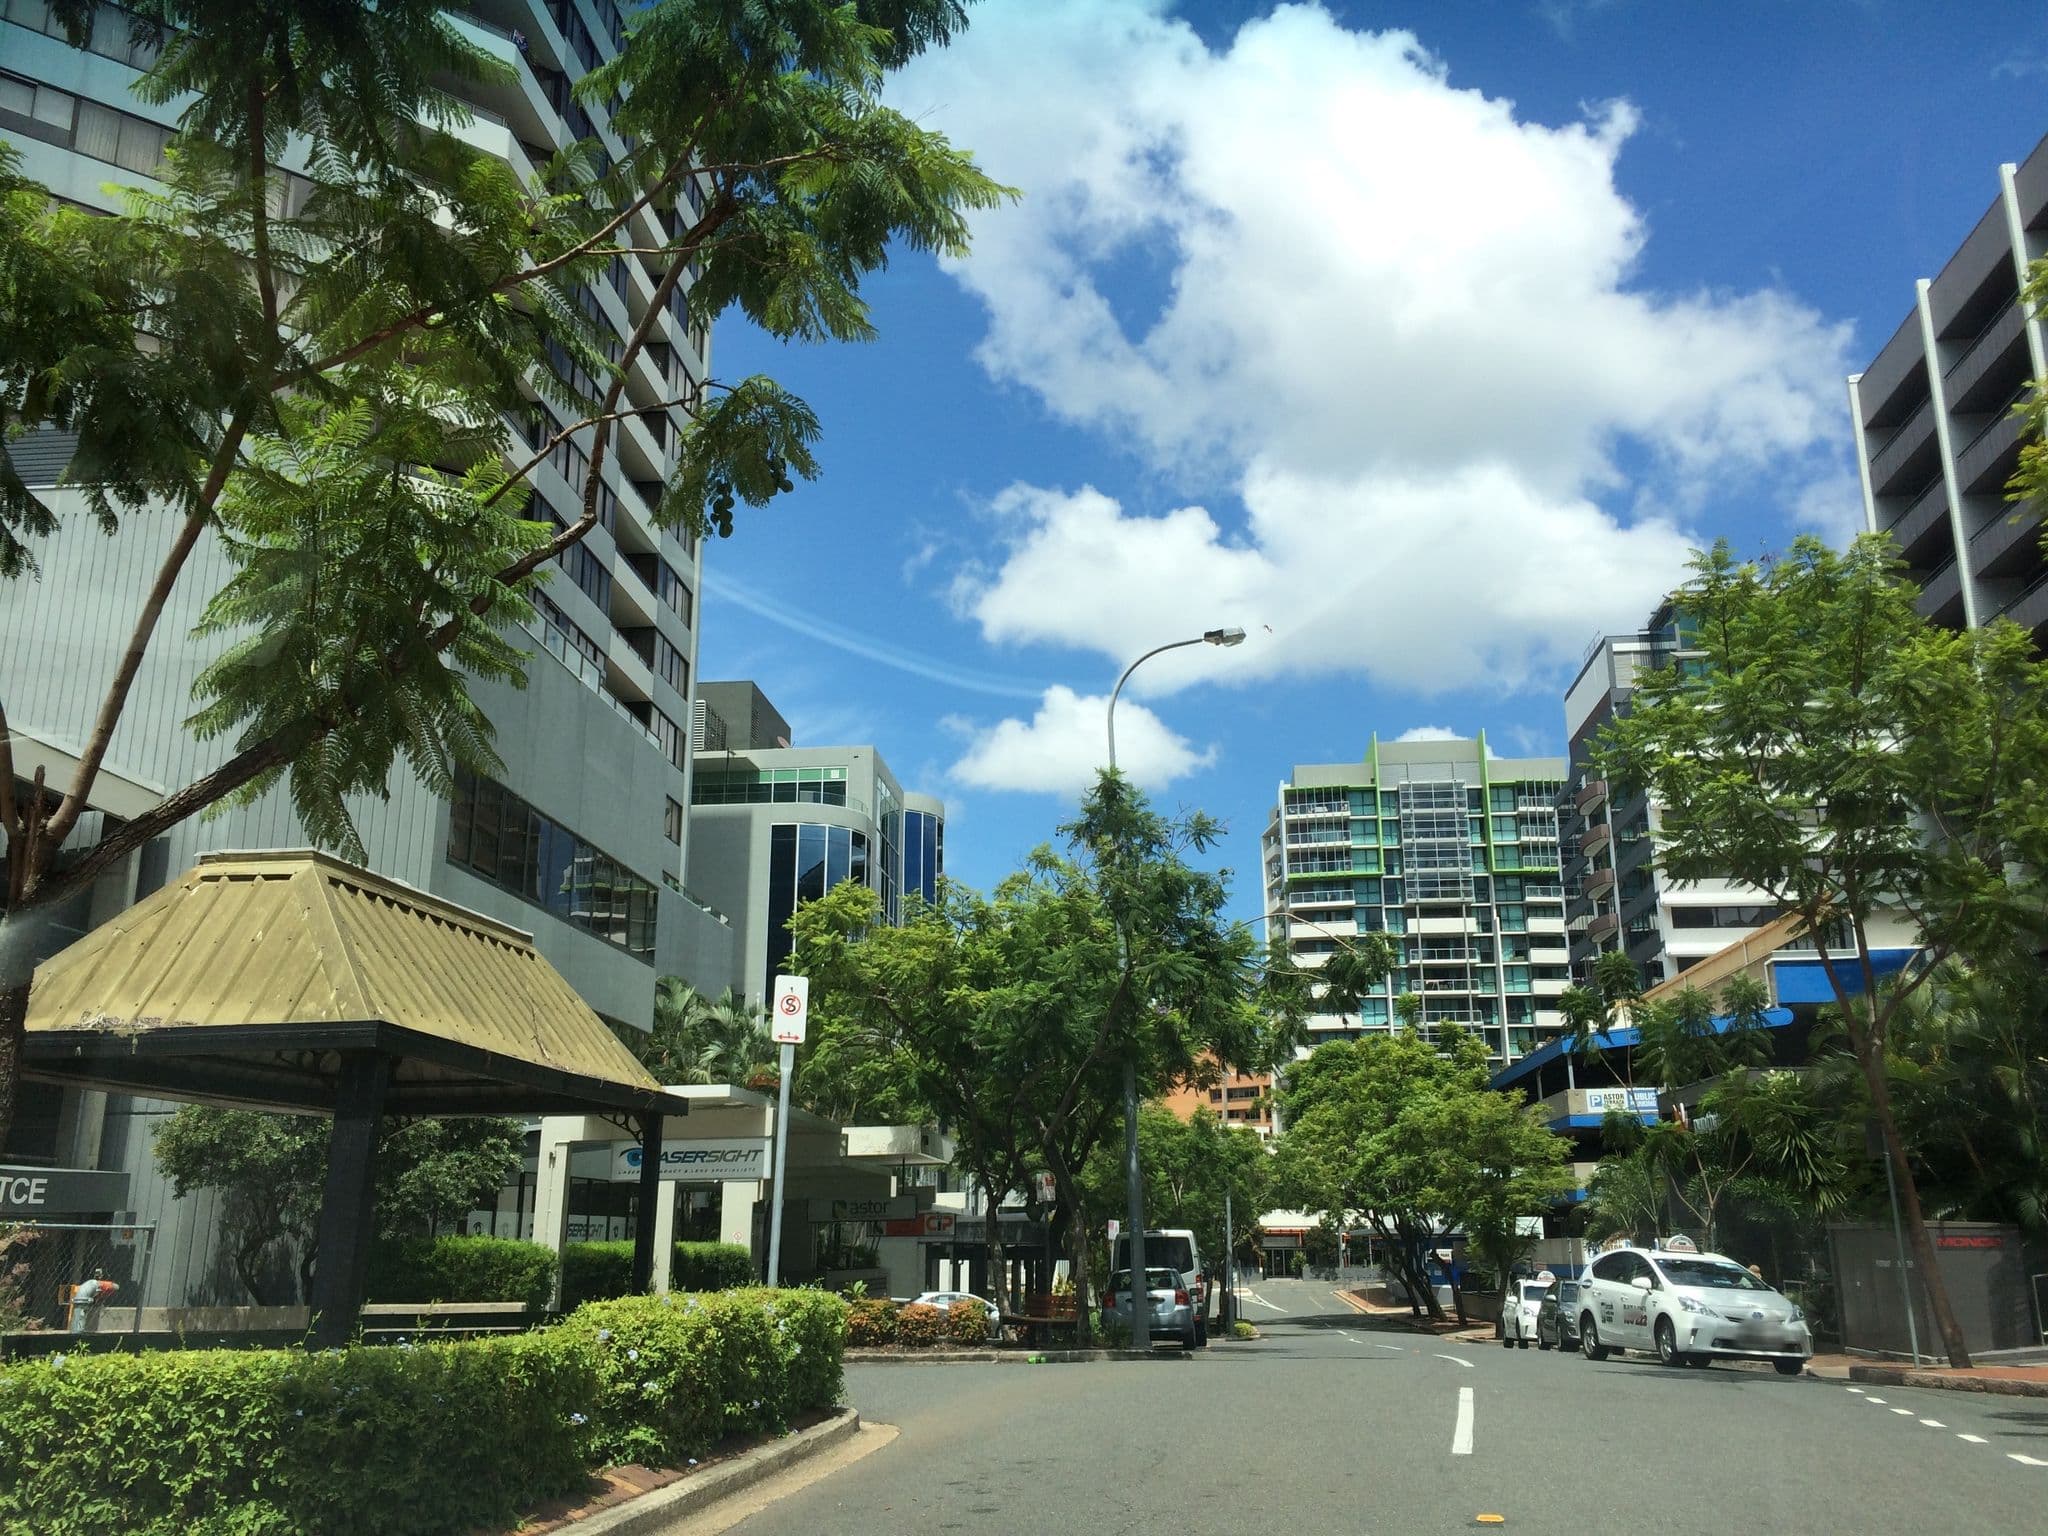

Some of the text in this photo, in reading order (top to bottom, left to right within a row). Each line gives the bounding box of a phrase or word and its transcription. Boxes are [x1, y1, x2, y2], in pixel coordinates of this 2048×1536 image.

[657, 1149, 765, 1164] ASERSIGHT
[0, 1176, 48, 1204] TCE
[850, 1199, 890, 1214] astor
